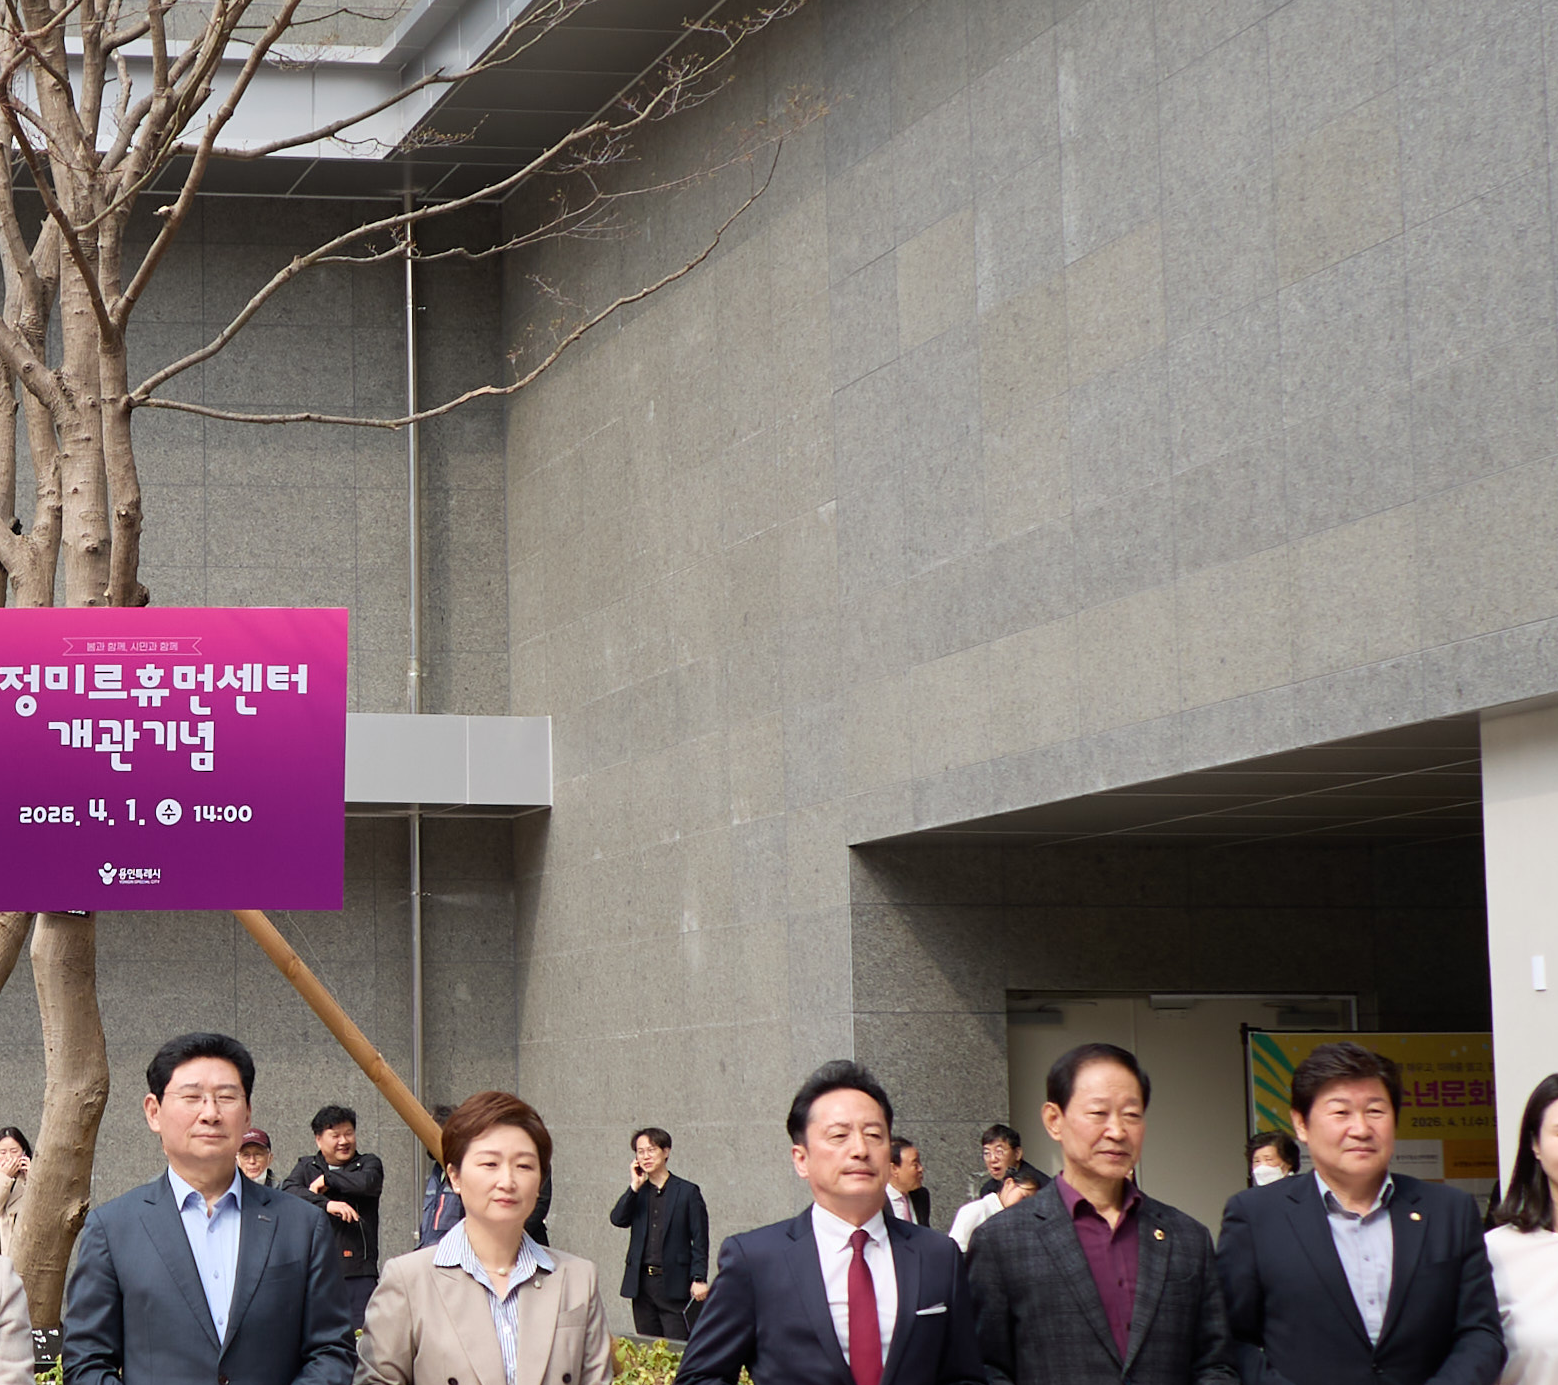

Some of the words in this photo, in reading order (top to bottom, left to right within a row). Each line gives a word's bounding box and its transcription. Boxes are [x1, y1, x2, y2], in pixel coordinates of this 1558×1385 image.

[130, 642, 157, 652] 시민과
[160, 642, 179, 652] 함께
[48, 718, 215, 772] 개관기념
[19, 806, 81, 826] 2026.
[193, 804, 253, 823] 14:00
[118, 867, 161, 880] 용인특례시
